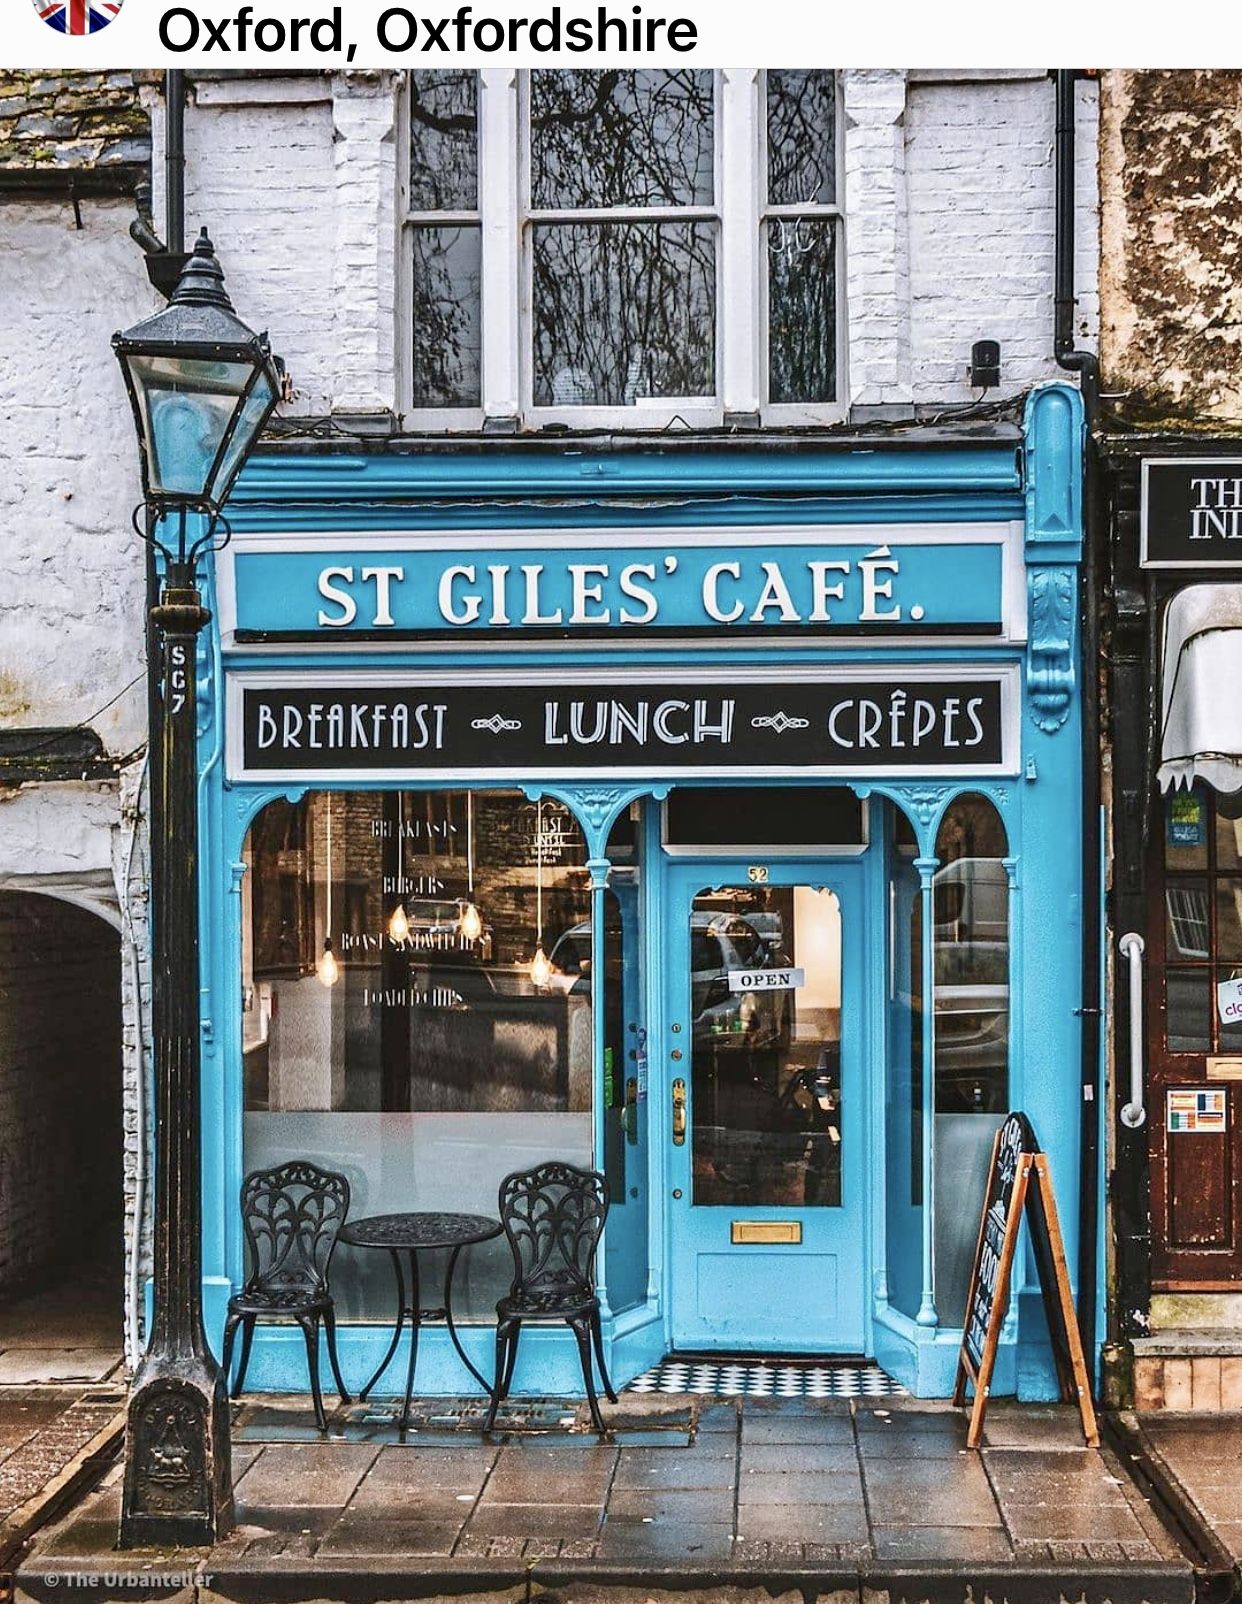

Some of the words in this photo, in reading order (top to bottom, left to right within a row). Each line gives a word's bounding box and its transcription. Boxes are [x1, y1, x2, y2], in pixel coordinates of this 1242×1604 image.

[318, 566, 404, 626] ST
[438, 555, 679, 626] GILES'
[702, 545, 925, 623] CAFÉ.
[258, 703, 448, 750] BREAKFAST
[544, 699, 736, 746] LUNCH
[827, 688, 984, 749] CRÊPES
[748, 867, 768, 882] 52
[740, 972, 791, 987] OPEN
